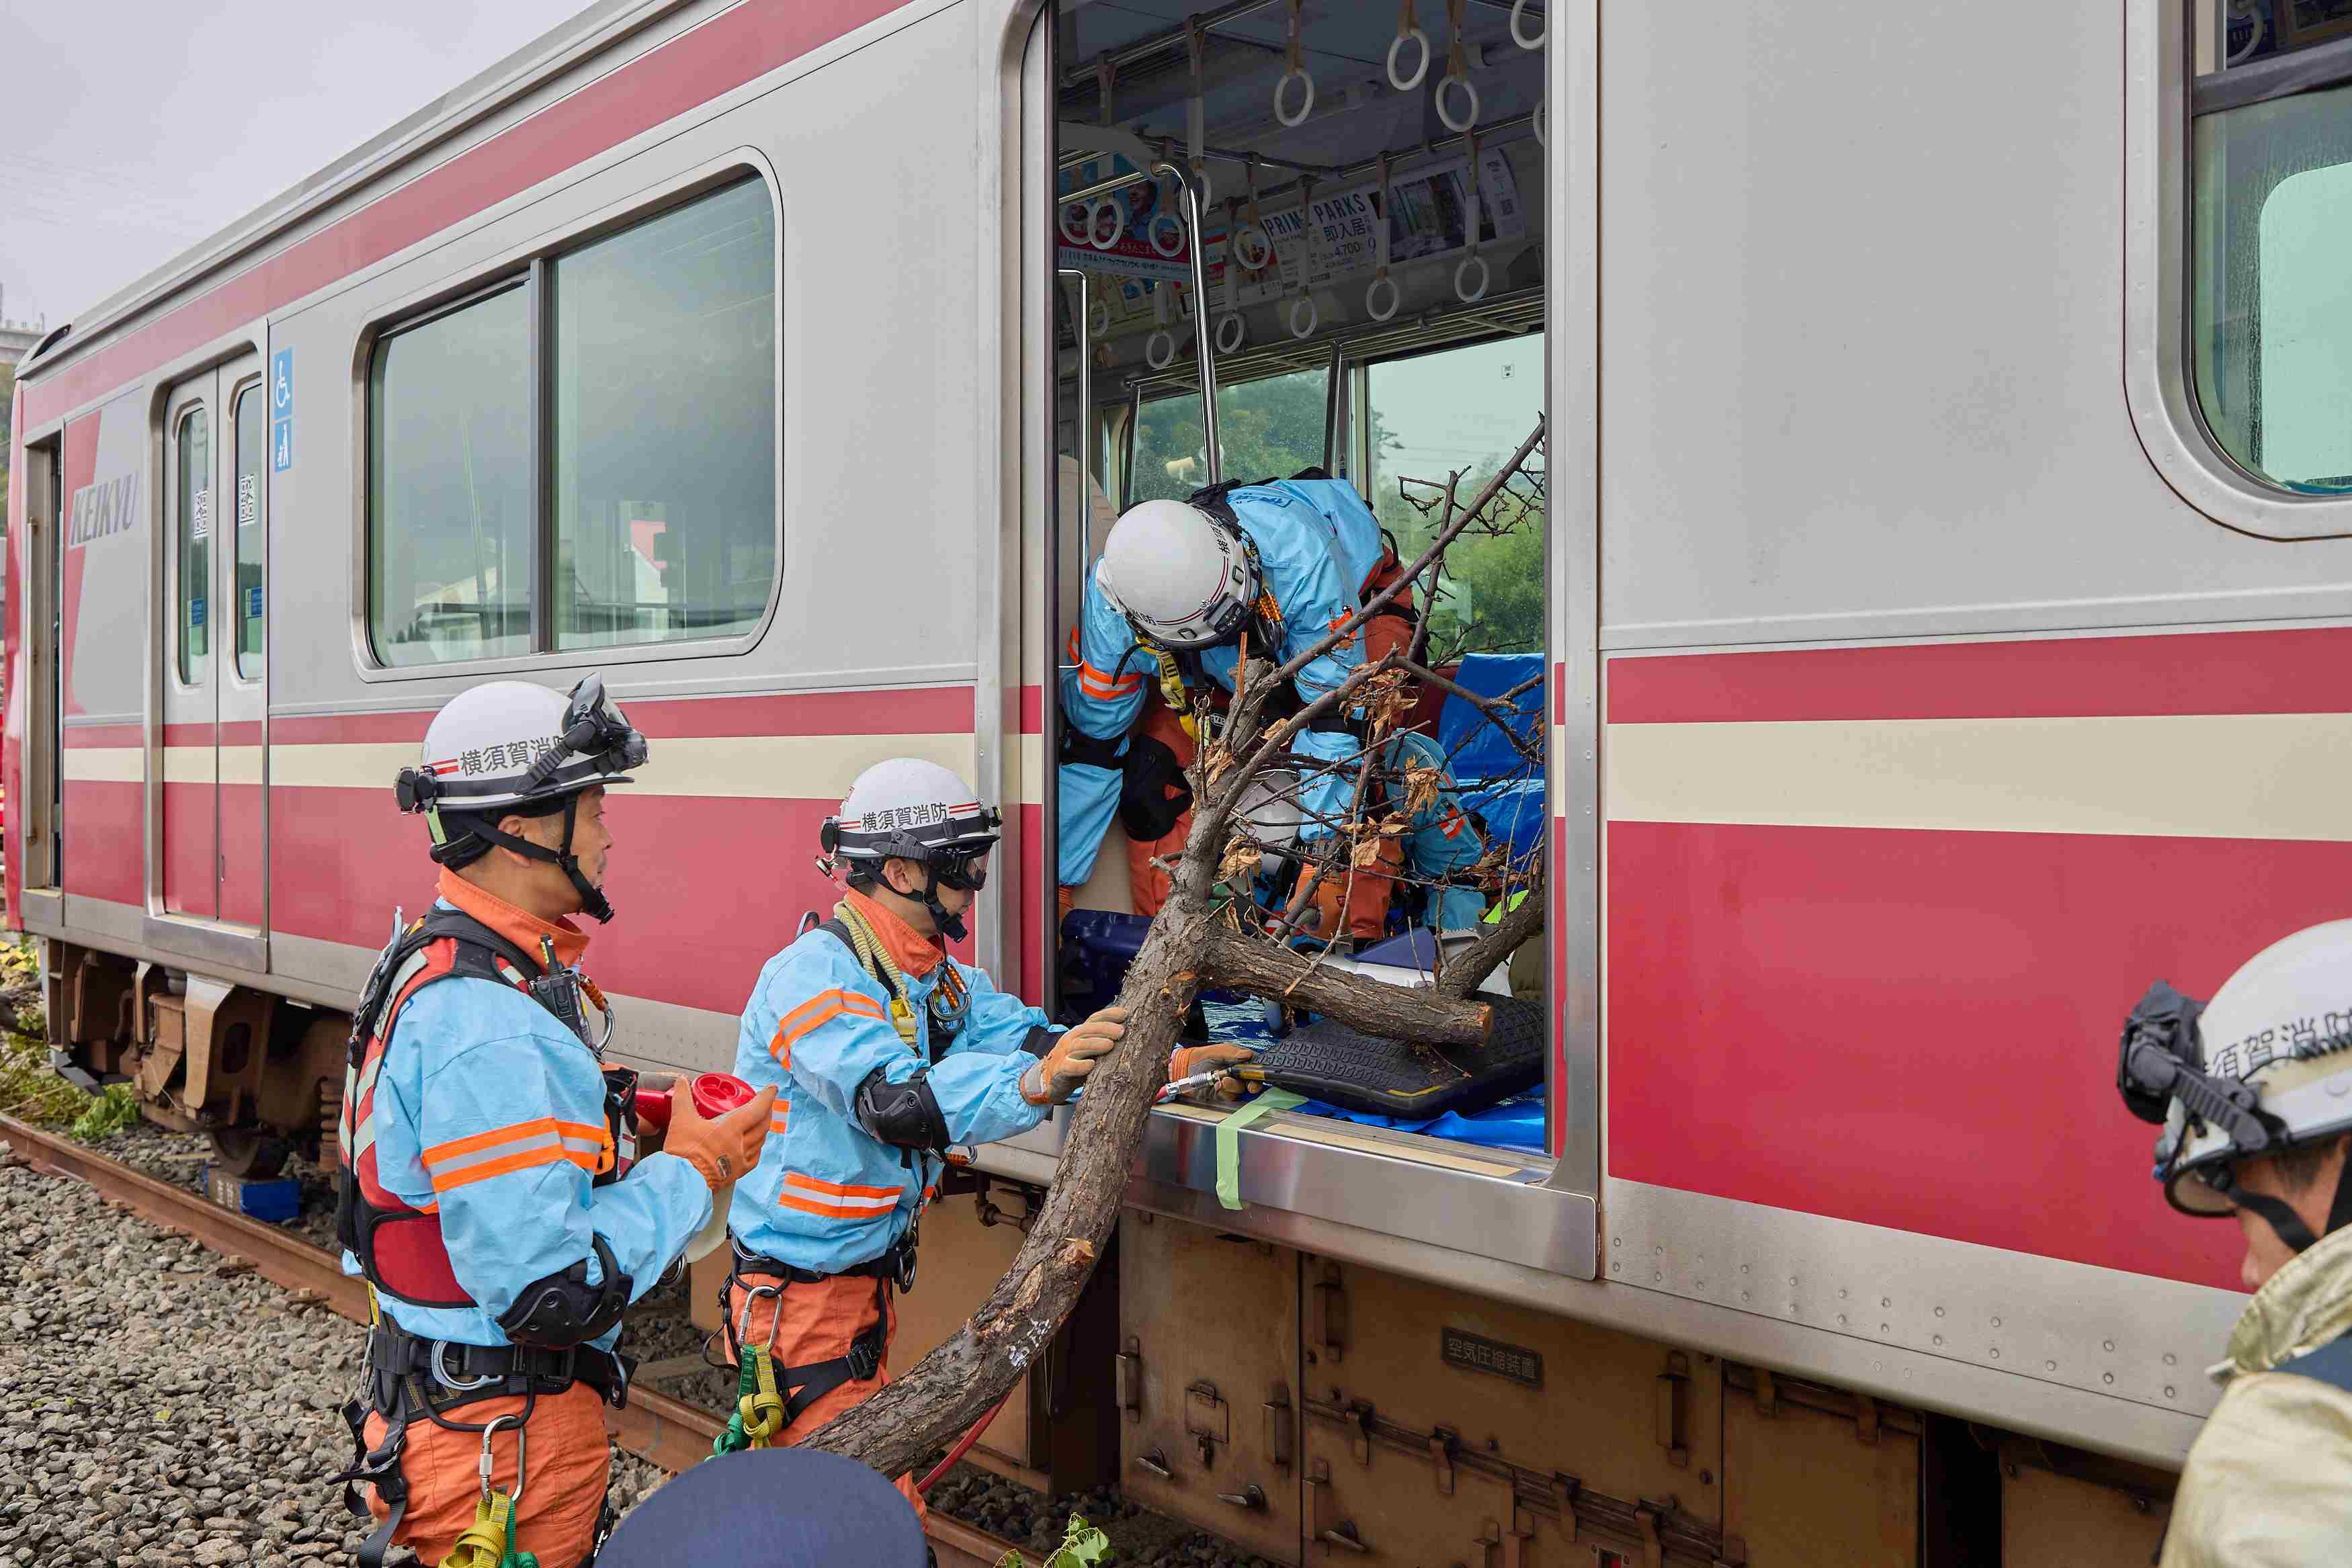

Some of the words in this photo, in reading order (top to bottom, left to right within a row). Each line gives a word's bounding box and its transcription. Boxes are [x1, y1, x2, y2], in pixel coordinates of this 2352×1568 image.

[1313, 193, 1366, 223] PARKS
[70, 470, 140, 546] KEIKYU
[862, 802, 948, 832] 横須賀消防
[1447, 1337, 1536, 1380] 空気圧縮装置
